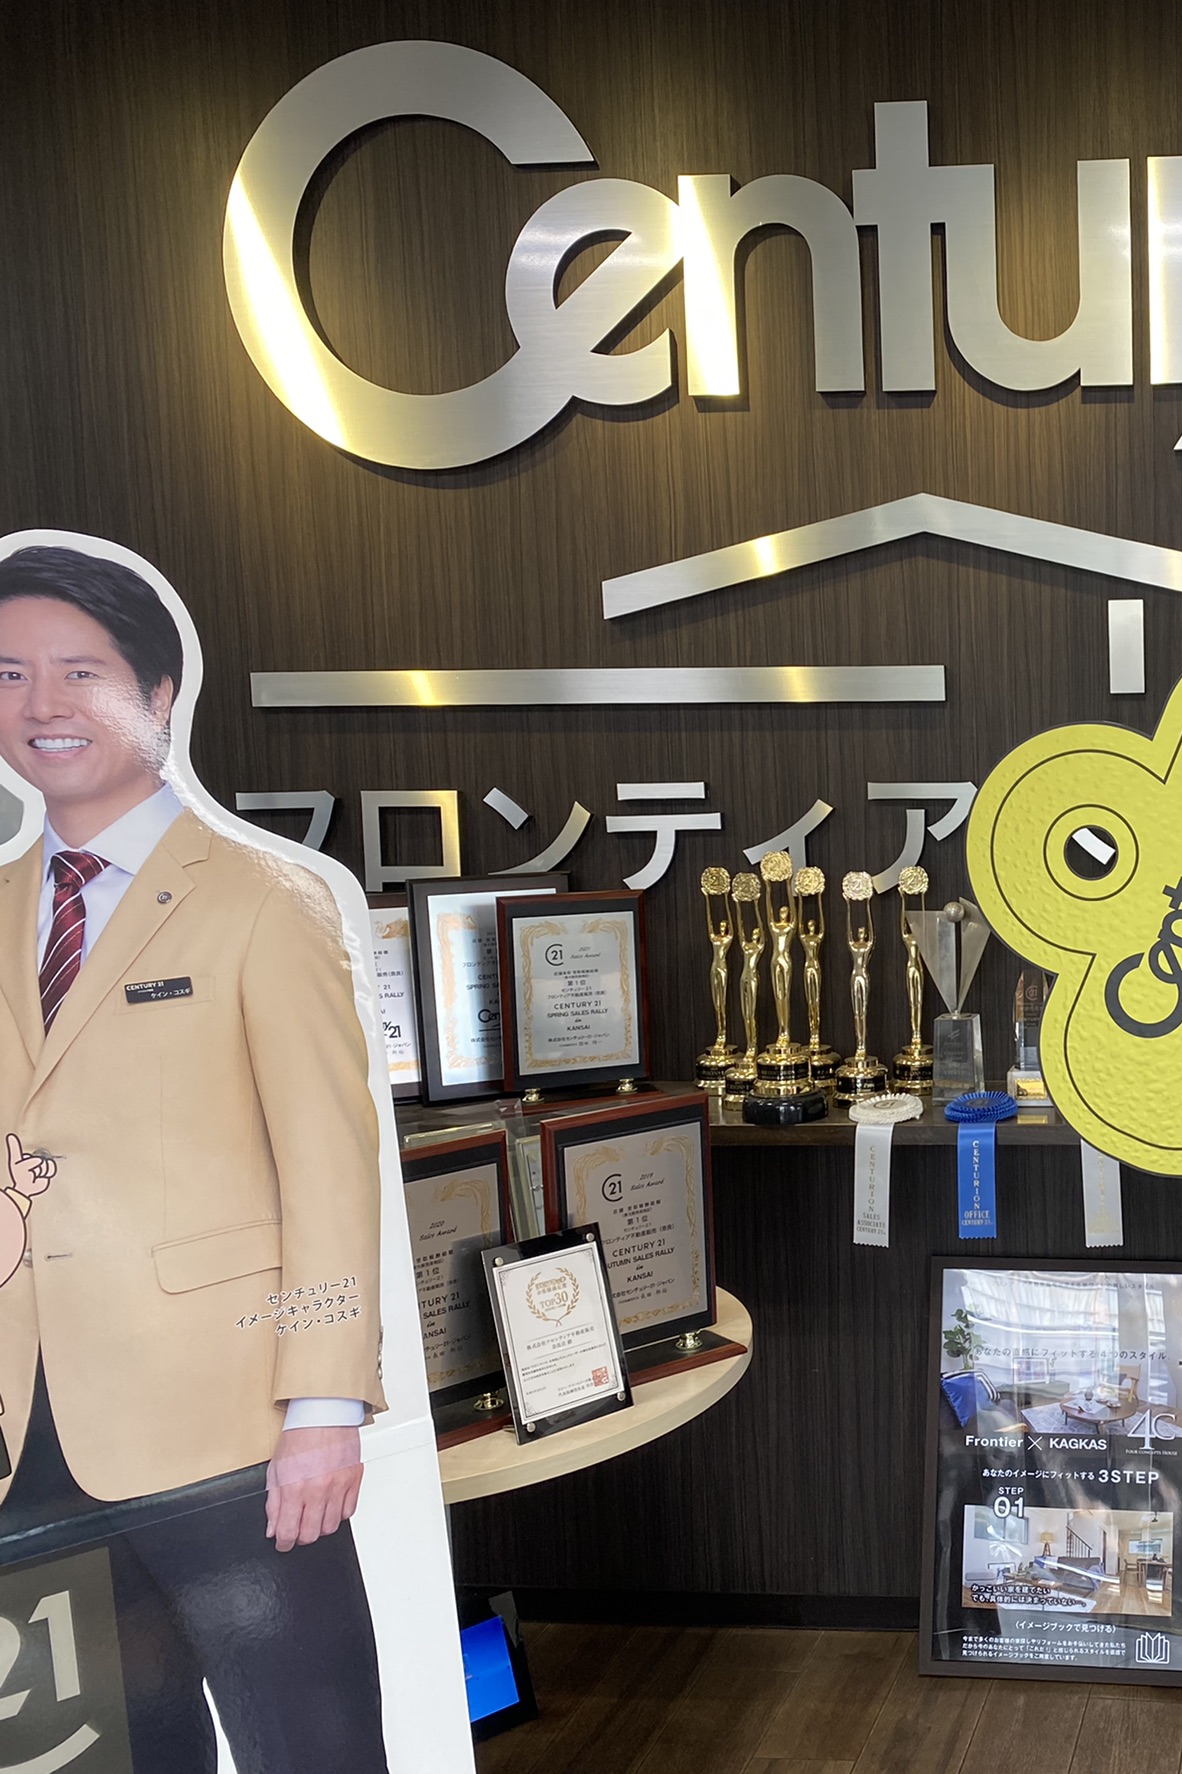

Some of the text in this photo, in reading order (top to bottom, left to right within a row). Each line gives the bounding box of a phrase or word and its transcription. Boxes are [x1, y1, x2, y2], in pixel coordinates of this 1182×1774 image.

[478, 973, 498, 981] CENT
[126, 982, 156, 991] CENTURY
[385, 991, 405, 999] RALLY
[554, 1001, 592, 1010] CENTURY
[570, 1009, 590, 1017] SALES
[566, 1024, 591, 1032] KANSAI
[868, 1145, 877, 1213] CENTURION
[972, 1140, 982, 1210] CENTURION
[862, 1211, 881, 1221] SALES
[964, 1210, 990, 1219] OFFICE
[857, 1219, 886, 1229] ASSOCIATE
[612, 1238, 666, 1258] CENTURY 21
[607, 1246, 676, 1270] UTUMN SALES RALLY
[627, 1271, 654, 1284] KANSAI
[267, 1276, 357, 1305] センチュリー21
[420, 1291, 461, 1310] TURY 21
[236, 1294, 359, 1328] イメージキャラクター
[423, 1300, 471, 1320] SALES RALLY
[276, 1306, 360, 1336] ケイン・コスギ
[423, 1328, 447, 1340] ANSAI
[965, 1435, 1024, 1448] Frontier
[1049, 1438, 1107, 1450] KAGKAS
[982, 1468, 1160, 1485] あなたのイメージにフィットする 3STEP
[998, 1486, 1024, 1495] STEP
[993, 1496, 1025, 1518] 01
